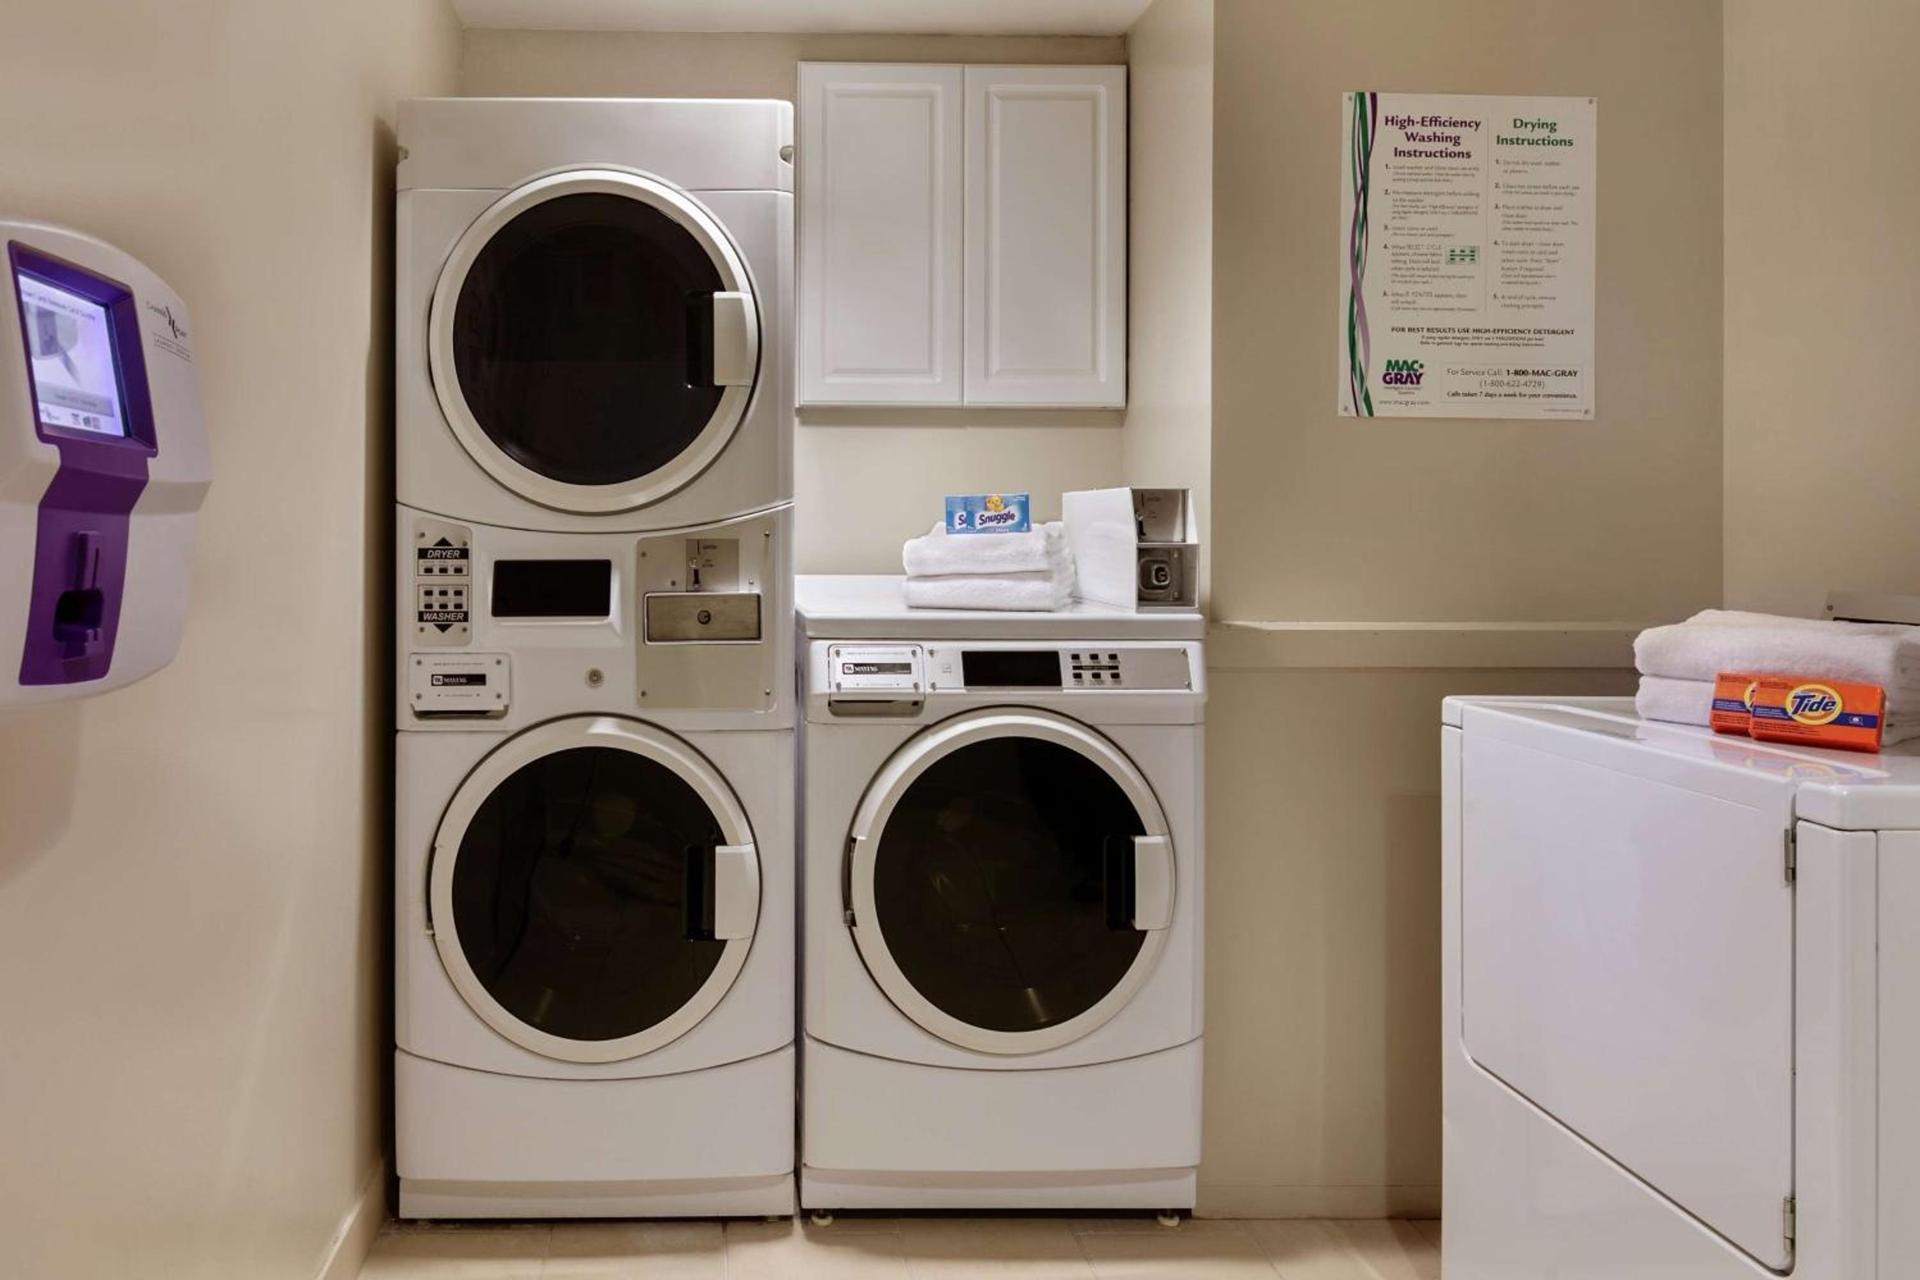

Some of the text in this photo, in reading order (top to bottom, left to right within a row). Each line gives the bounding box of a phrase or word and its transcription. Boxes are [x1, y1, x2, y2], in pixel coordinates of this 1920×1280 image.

[1384, 115, 1482, 130] High-Efficiency
[1513, 118, 1557, 133] Drying
[1405, 132, 1461, 147] Washing
[1496, 134, 1574, 147] Instructions
[1393, 147, 1472, 159] Instructions
[1382, 372, 1424, 385] GRAY
[1447, 368, 1459, 376] For
[1460, 368, 1485, 376] Service
[1506, 369, 1578, 378] 1-800-MAC-GRAY
[1484, 392, 1497, 400] days
[978, 511, 1016, 526] Snuggle
[427, 549, 460, 559] DRYER
[423, 612, 465, 621] WASHER
[1792, 694, 1837, 715] Tide
